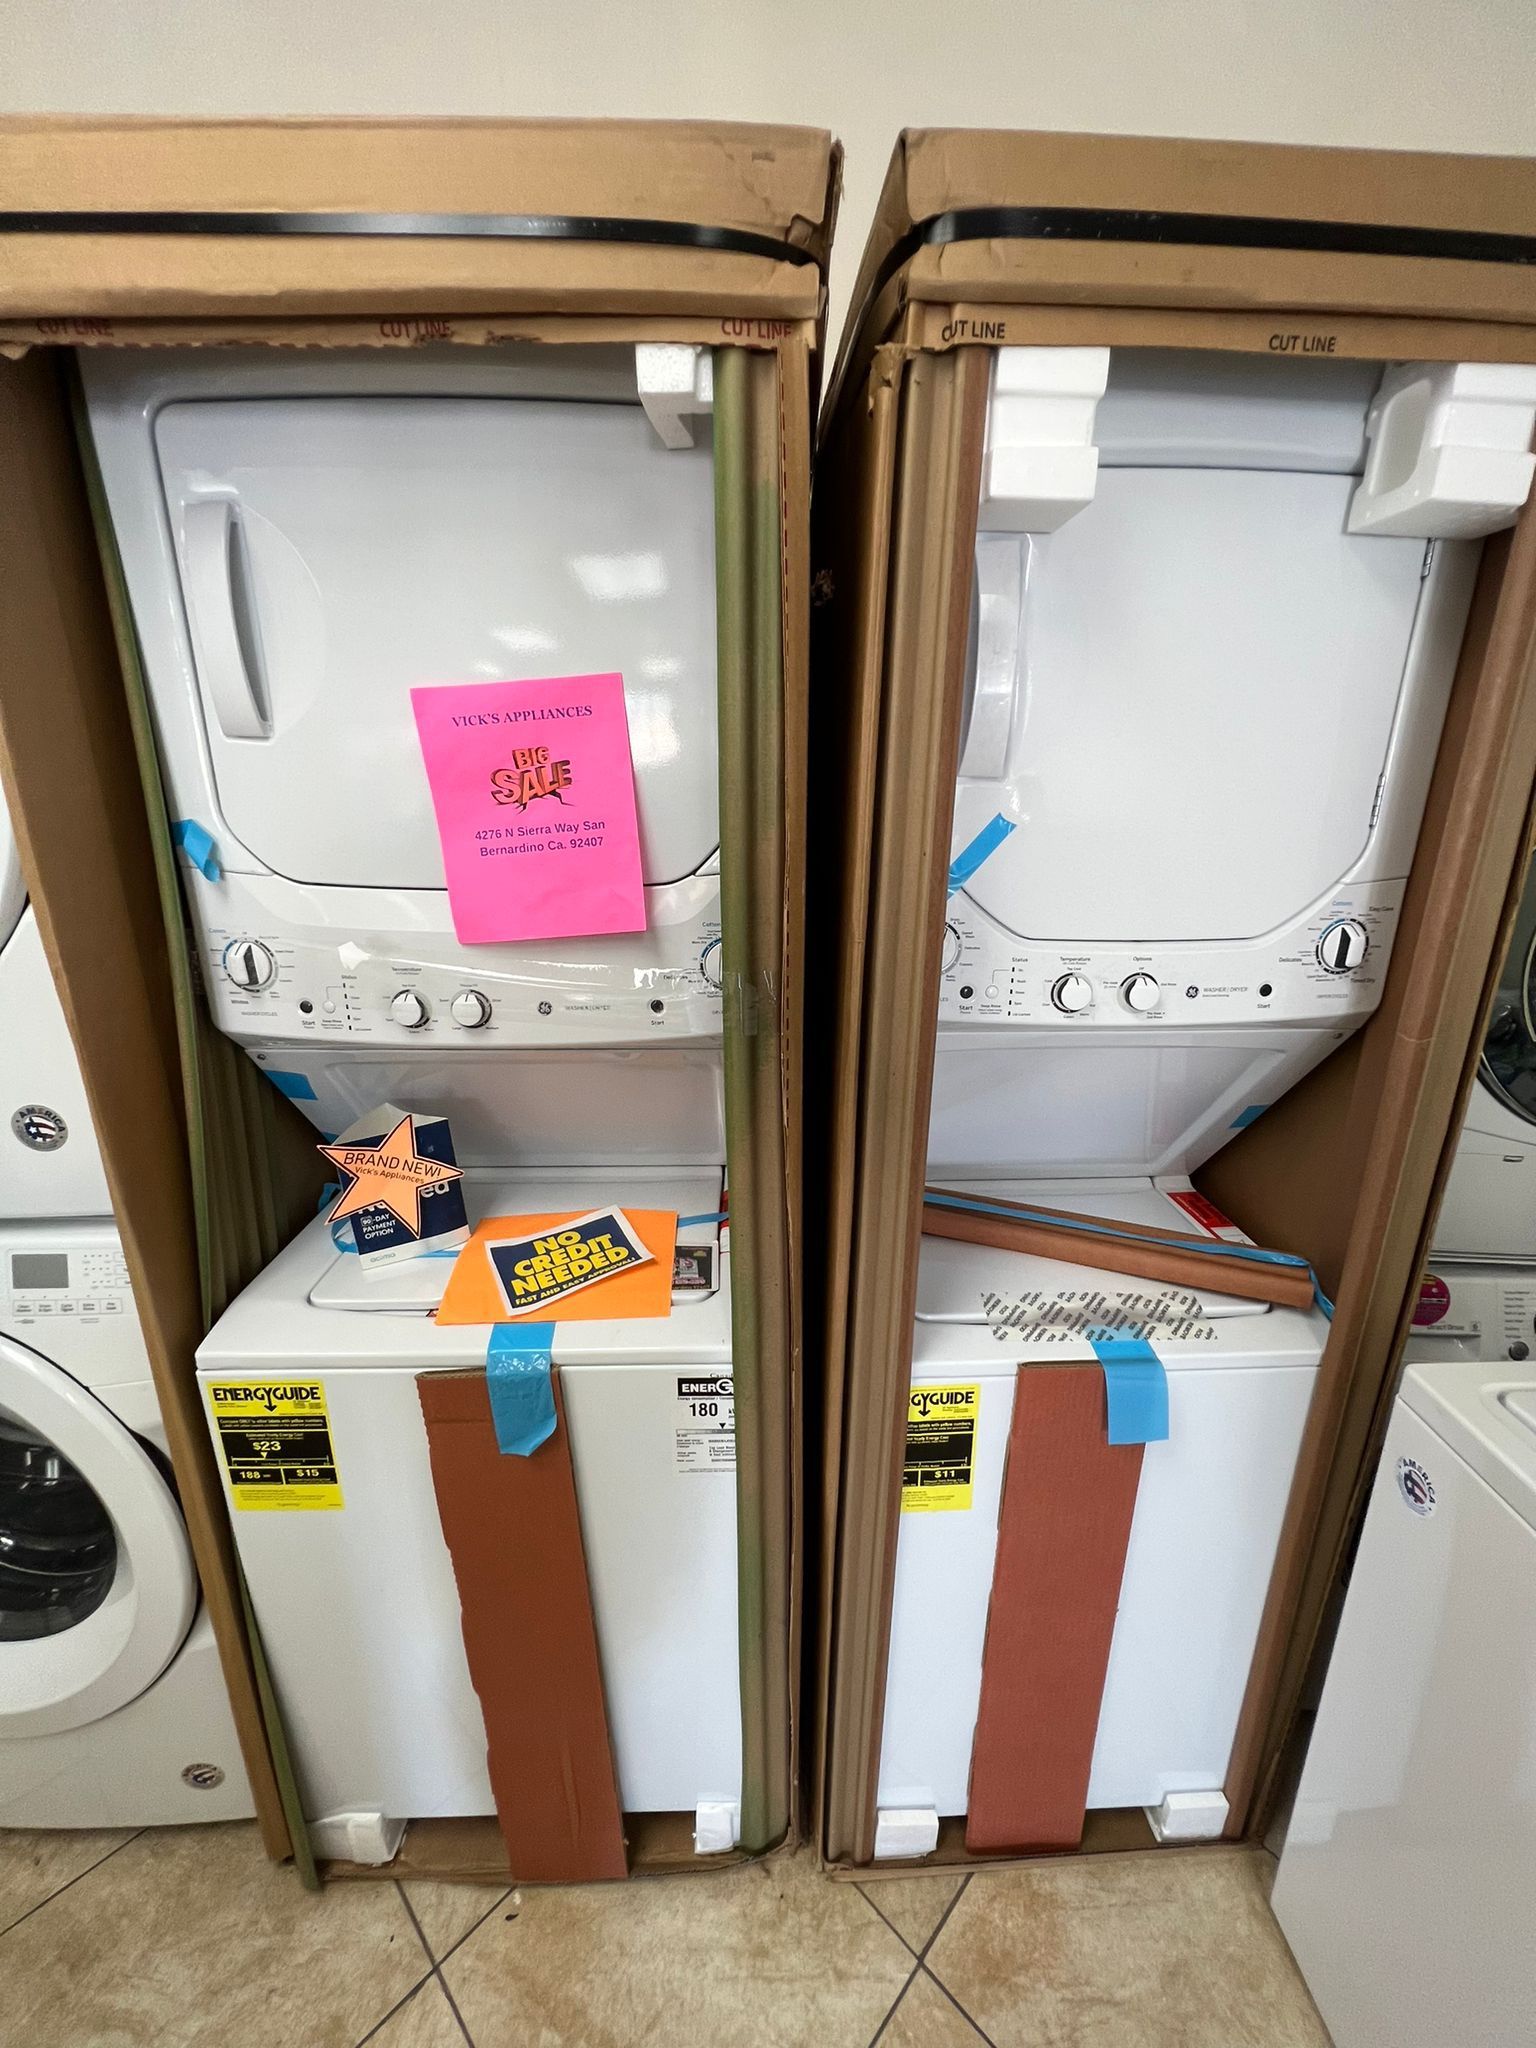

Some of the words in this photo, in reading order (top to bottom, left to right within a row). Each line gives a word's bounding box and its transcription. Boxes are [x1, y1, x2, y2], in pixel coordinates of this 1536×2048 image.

[380, 319, 410, 338] CUT
[721, 319, 753, 337] CUT
[941, 320, 968, 342] CUT
[971, 321, 1006, 339] LINE
[1268, 334, 1300, 351] CUT
[1302, 335, 1337, 353] LINE
[451, 712, 500, 727] VICK'S
[503, 705, 593, 723] APPLIANCES
[512, 746, 549, 769] BIG
[490, 760, 573, 805] SALE
[475, 829, 502, 841] 4276
[505, 828, 514, 838] N
[517, 825, 552, 837] Sierra
[554, 823, 580, 834] Way
[583, 820, 606, 831] San
[480, 843, 544, 857] Bernardino
[547, 840, 567, 851] Ca.
[569, 836, 604, 849] 92407
[19, 1107, 66, 1132] AMERICA
[343, 1152, 400, 1169] BRAND
[402, 1159, 442, 1179] NEW!
[355, 1166, 378, 1177] Vick's
[379, 1170, 425, 1185] Appliances
[362, 1220, 397, 1234] PAYMENT
[364, 1227, 394, 1240] OPTION
[533, 1230, 581, 1255] NO
[513, 1233, 612, 1277] CREDIT
[511, 1246, 630, 1296] NEEDED
[515, 1294, 540, 1306] FAST
[540, 1286, 561, 1299] AND
[562, 1277, 586, 1290] EASY
[212, 1386, 321, 1402] ENERGYGUIDE
[689, 1402, 718, 1417] 180
[252, 1440, 282, 1451] $23
[239, 1470, 261, 1479] 188
[296, 1469, 320, 1477] $15
[1402, 1458, 1436, 1504] AMERICA
